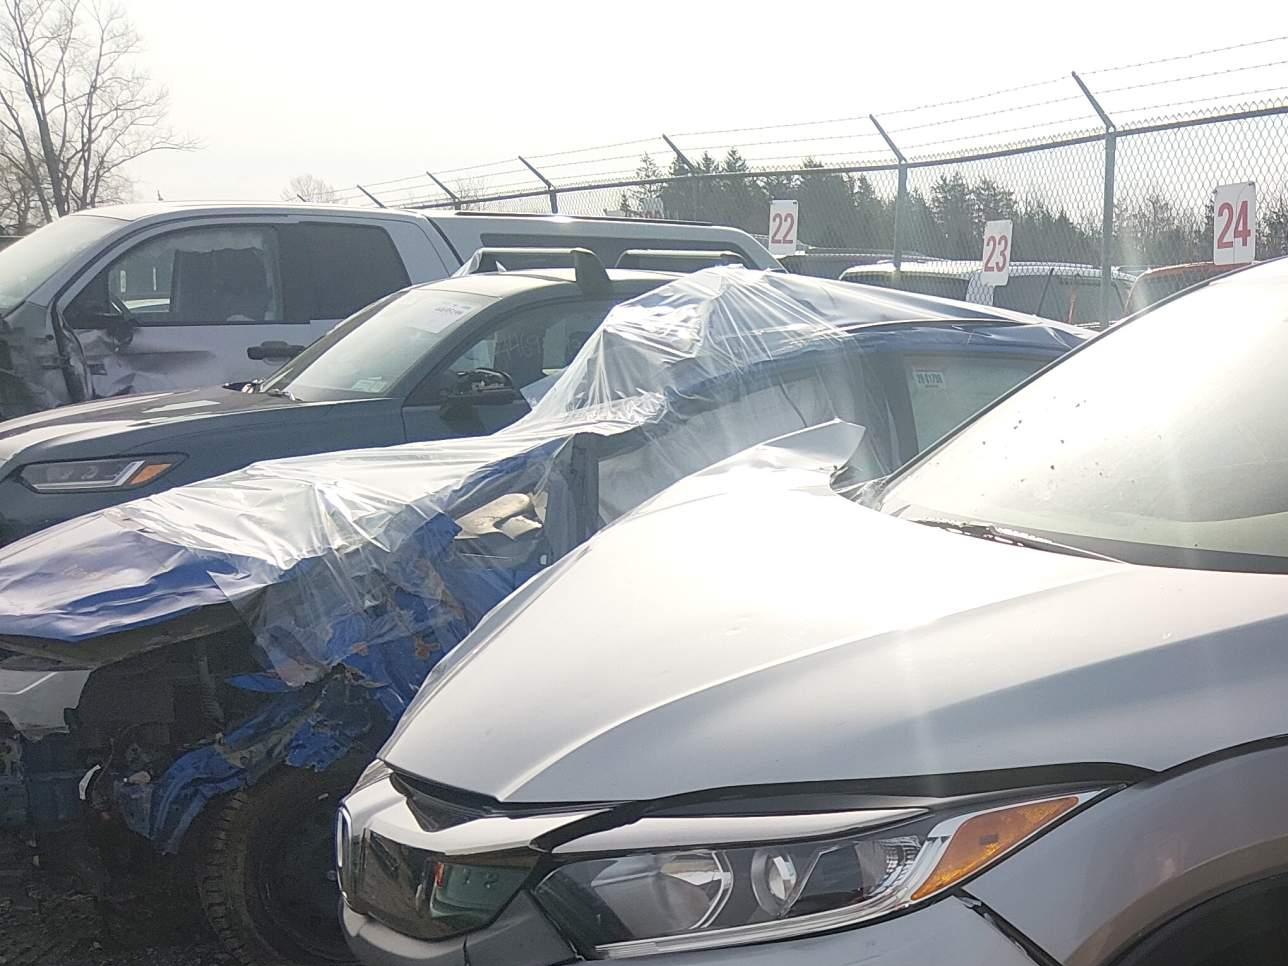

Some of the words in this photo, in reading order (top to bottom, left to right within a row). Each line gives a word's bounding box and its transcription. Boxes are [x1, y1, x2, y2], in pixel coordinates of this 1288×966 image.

[771, 212, 795, 245] 22
[1216, 200, 1251, 249] 24
[983, 234, 1009, 273] 23
